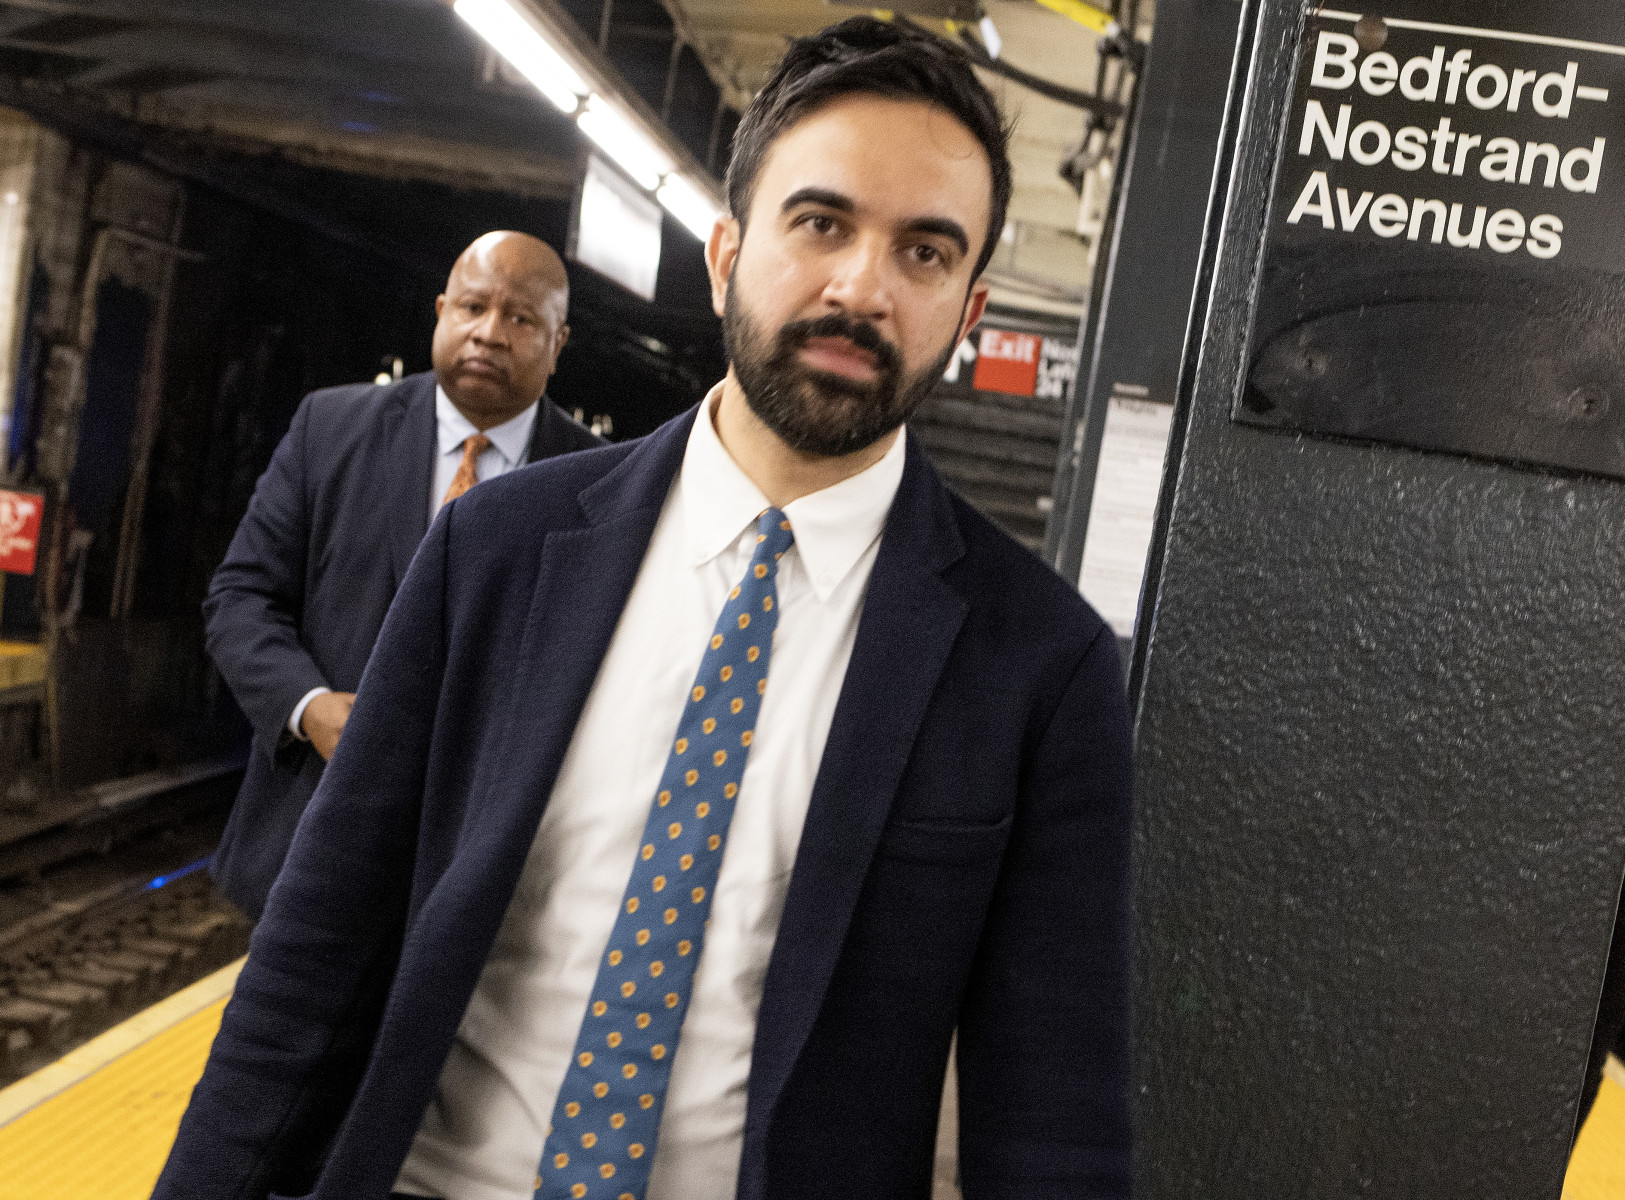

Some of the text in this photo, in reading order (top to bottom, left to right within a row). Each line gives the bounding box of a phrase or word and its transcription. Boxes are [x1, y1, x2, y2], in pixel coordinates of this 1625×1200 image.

[1298, 100, 1606, 194] Nostrand
[1286, 170, 1564, 260] Avenues
[979, 330, 1035, 364] Exit
